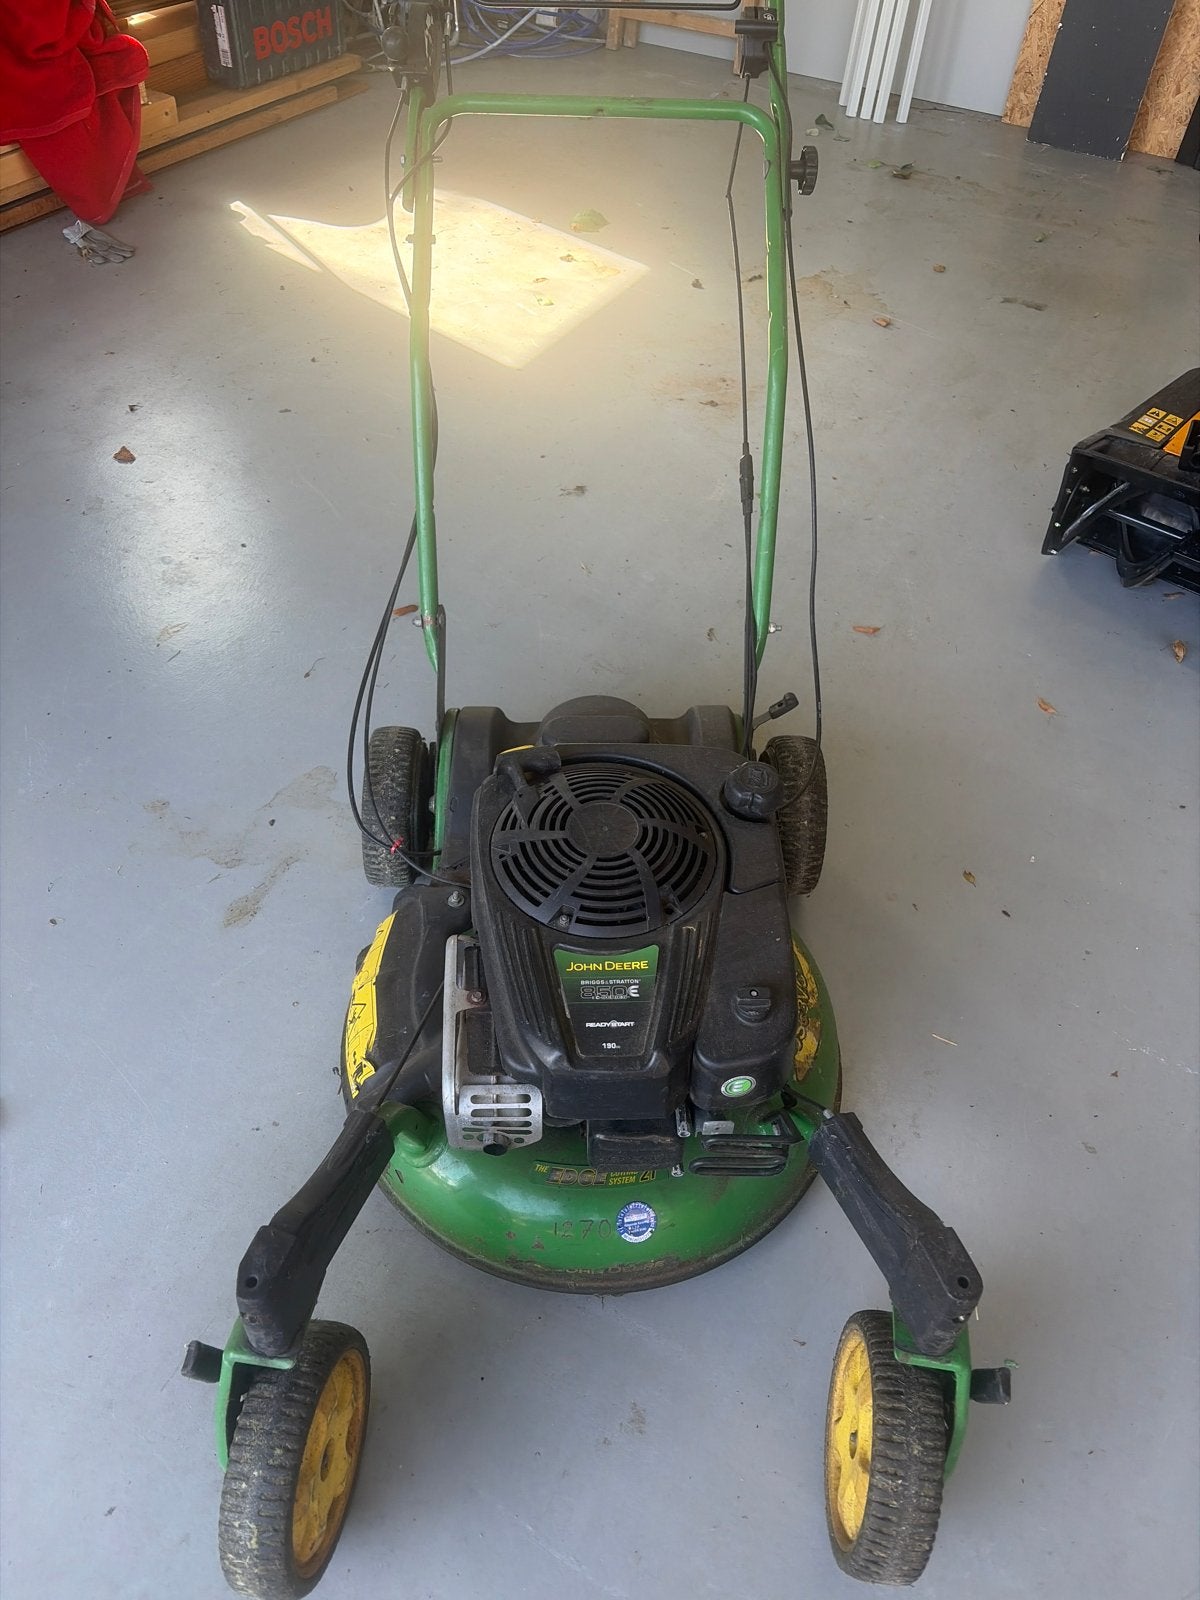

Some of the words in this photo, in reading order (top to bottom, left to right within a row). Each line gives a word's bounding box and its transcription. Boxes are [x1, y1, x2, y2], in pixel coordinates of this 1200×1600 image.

[253, 4, 333, 61] BOSCH
[566, 962, 603, 972] JOHN
[604, 960, 649, 971] DEERE
[535, 1163, 550, 1173] THE
[545, 1167, 609, 1187] EDGE
[609, 1175, 636, 1186] SYSTEM
